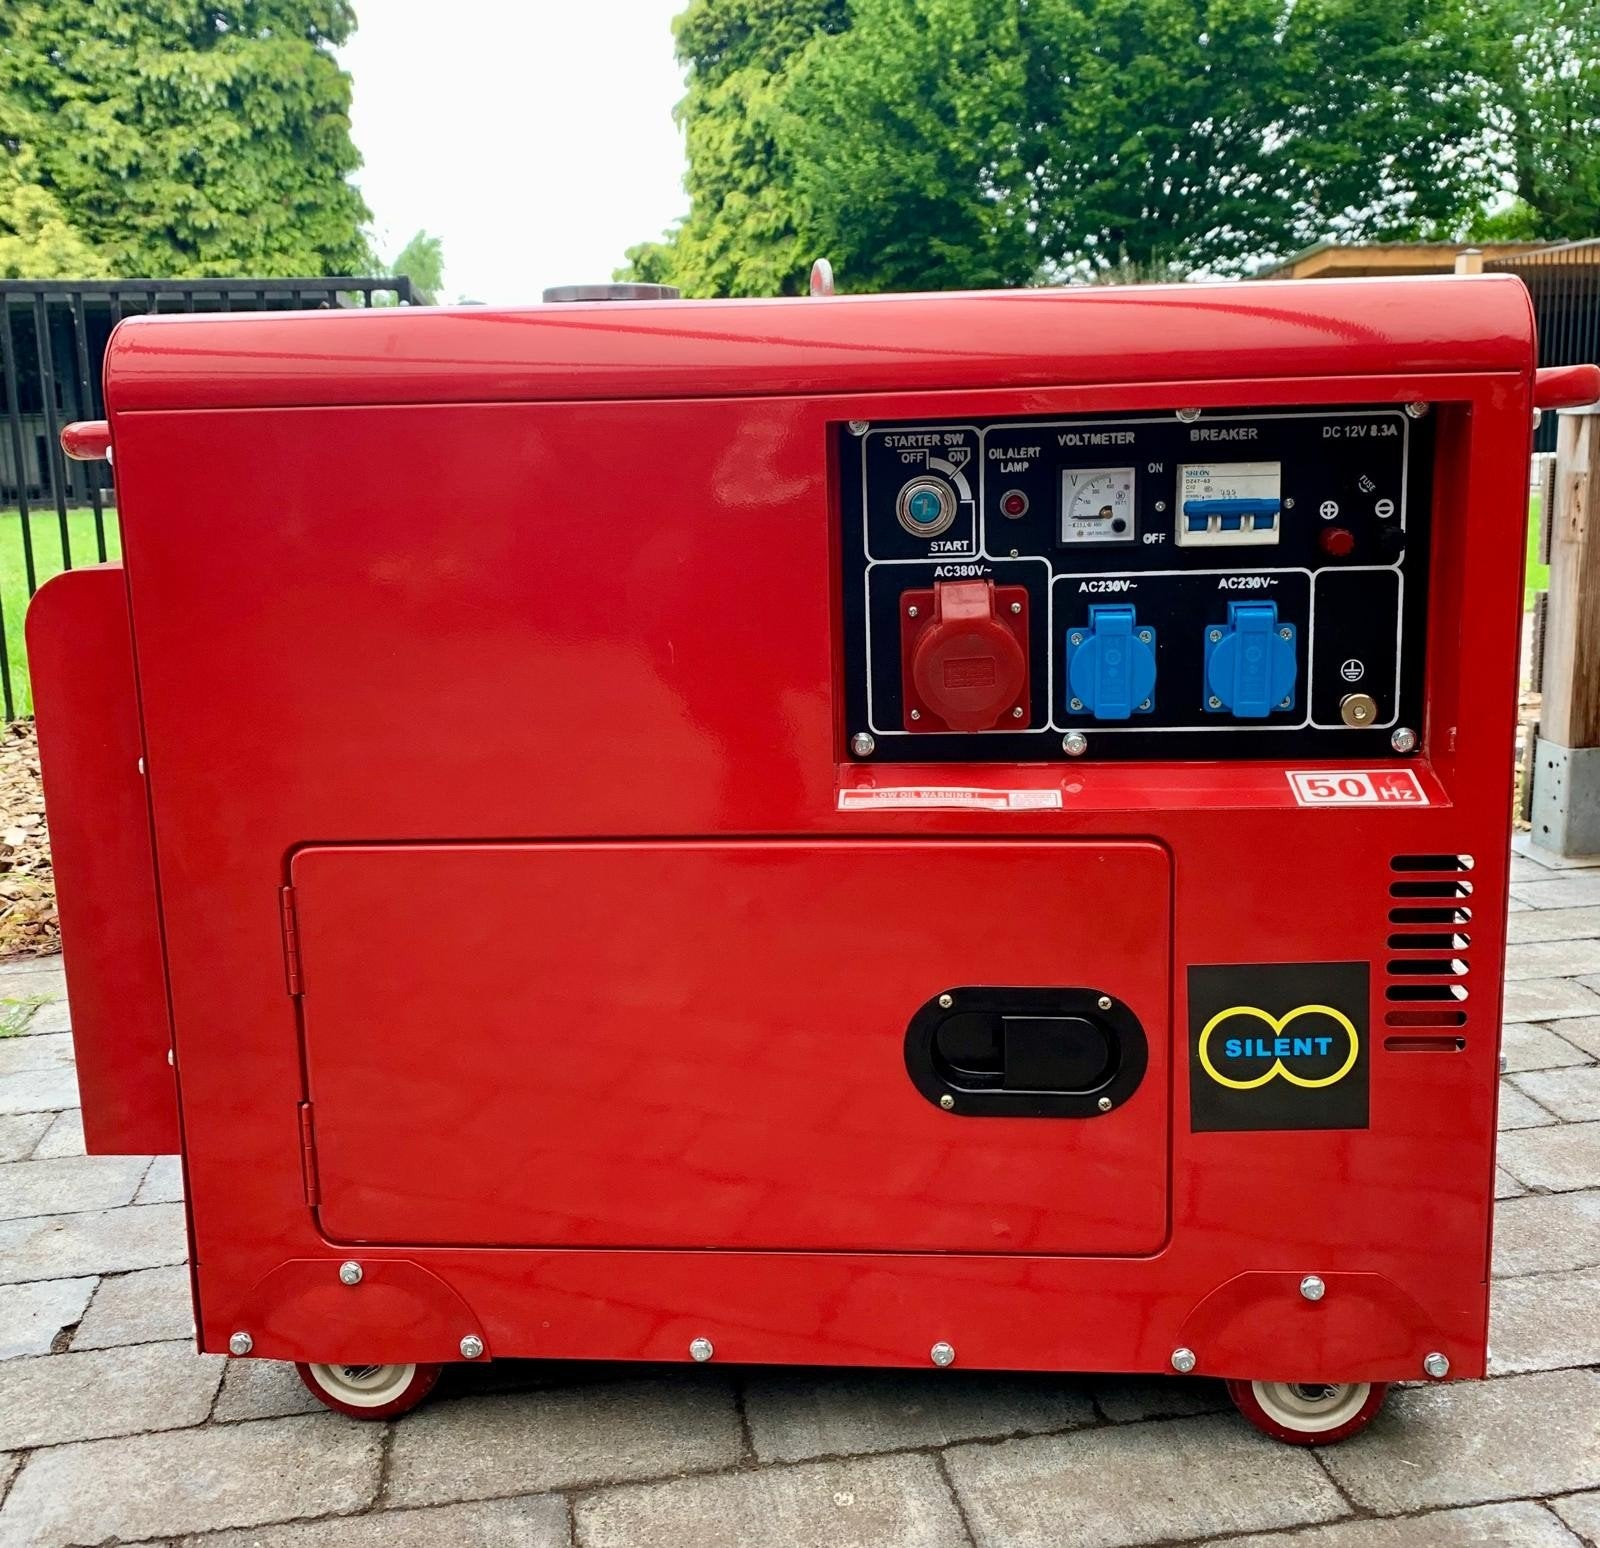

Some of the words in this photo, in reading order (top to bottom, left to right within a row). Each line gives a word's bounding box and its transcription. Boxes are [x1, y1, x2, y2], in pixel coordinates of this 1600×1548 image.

[1190, 428, 1258, 441] BREAKER
[1322, 426, 1341, 438] DC
[1344, 425, 1367, 438] 12V
[1370, 424, 1398, 437] 8.3A
[884, 434, 941, 447] STARTER
[944, 433, 964, 445] SW
[1057, 432, 1136, 446] VOLTMETER
[901, 452, 924, 464] OFF
[948, 451, 965, 462] ON
[988, 448, 1006, 460] OIL
[1006, 447, 1041, 459] ALERT
[1000, 461, 1029, 472] LAMP
[1148, 462, 1163, 474] ON
[1360, 475, 1376, 492] FUSE
[930, 540, 970, 551] START
[1143, 533, 1166, 545] OFF
[872, 791, 897, 799] LOW
[899, 790, 918, 799] OIL
[920, 791, 971, 800] WARNING
[1307, 778, 1367, 798] 50
[1380, 786, 1417, 800] Hz
[1225, 1037, 1333, 1058] SILENT
